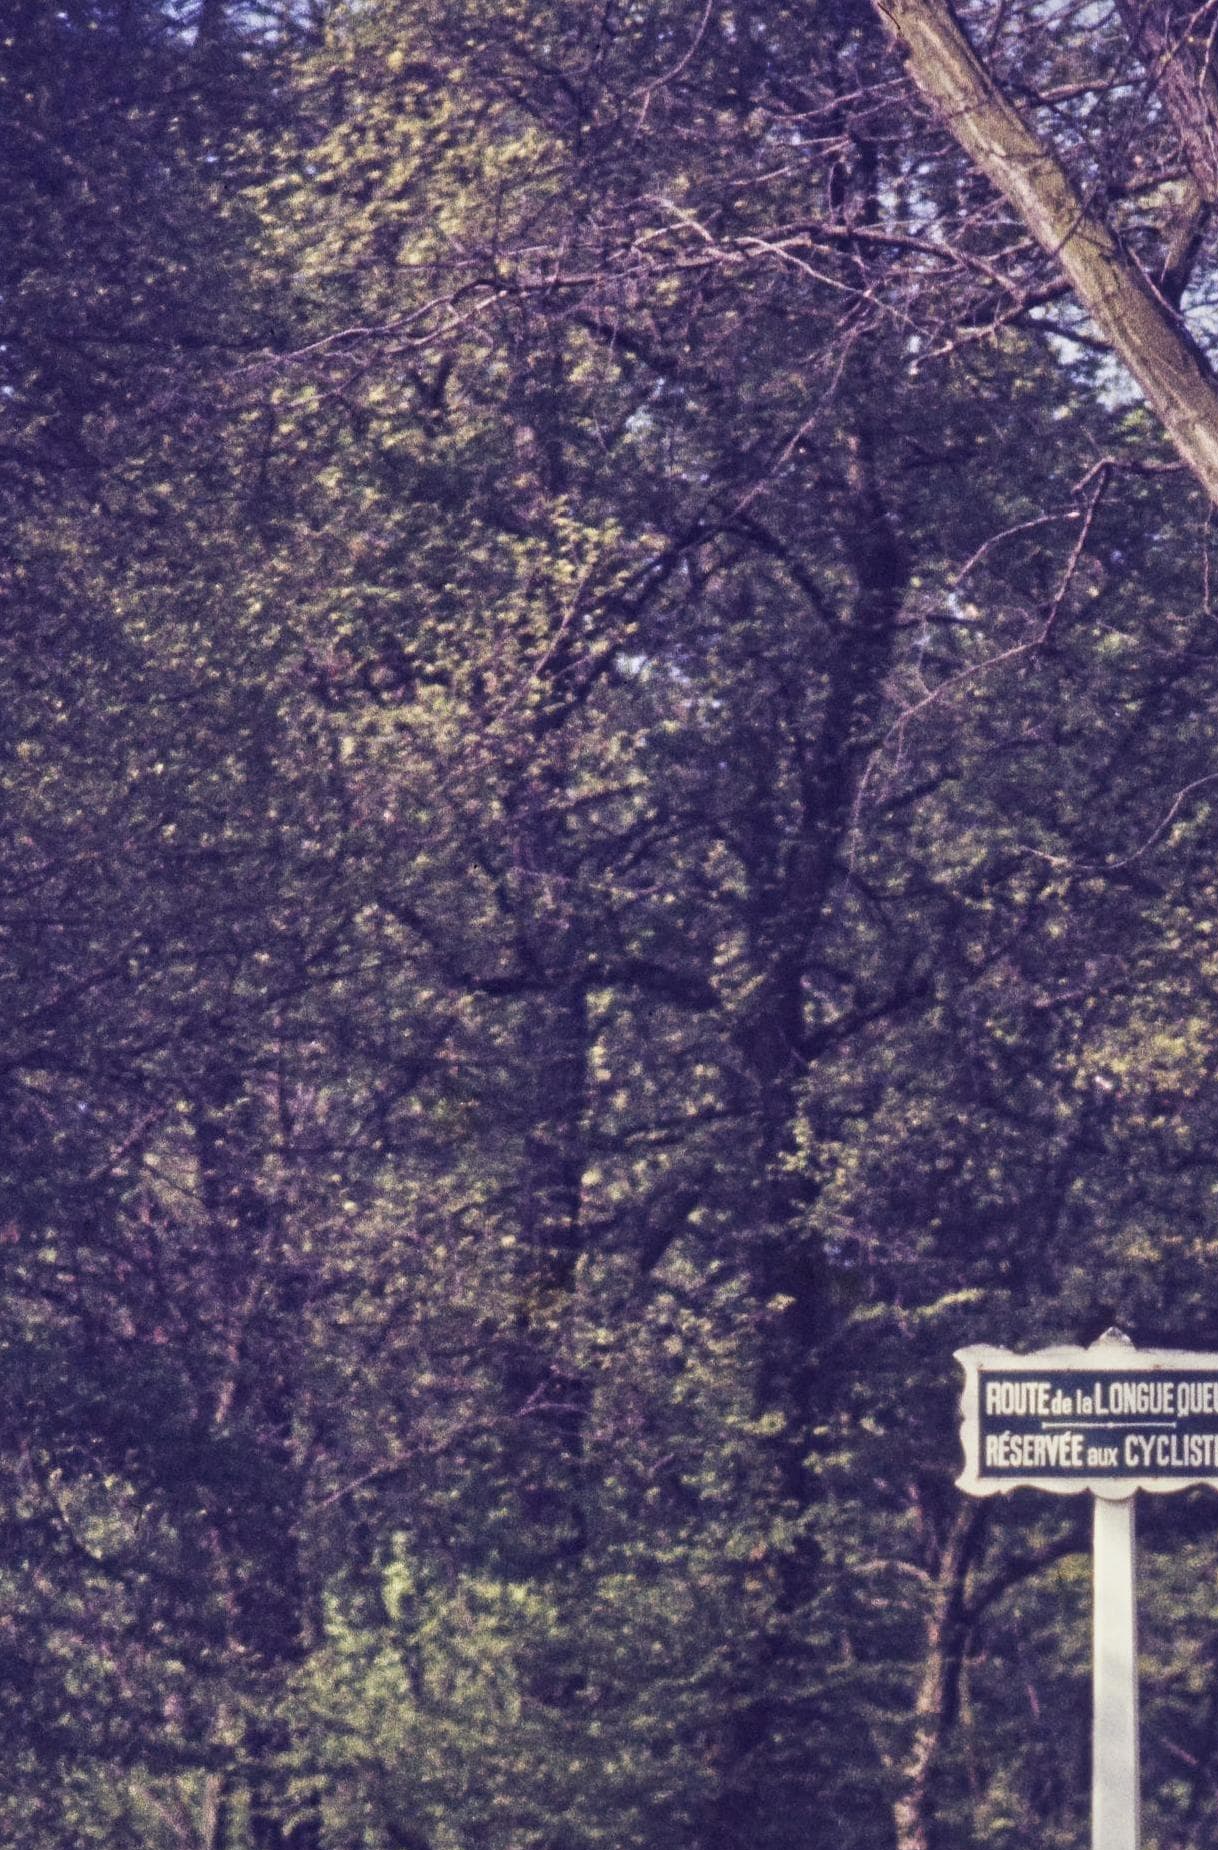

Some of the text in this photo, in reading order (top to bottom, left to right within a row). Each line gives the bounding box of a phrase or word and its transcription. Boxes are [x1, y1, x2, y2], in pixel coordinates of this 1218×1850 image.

[986, 1382, 1051, 1415] ROUTE
[1051, 1389, 1072, 1414] de
[1076, 1389, 1093, 1414] la
[1094, 1382, 1174, 1415] LONGUE
[986, 1430, 1084, 1467] RÉSERVÉE
[1086, 1446, 1118, 1467] aux
